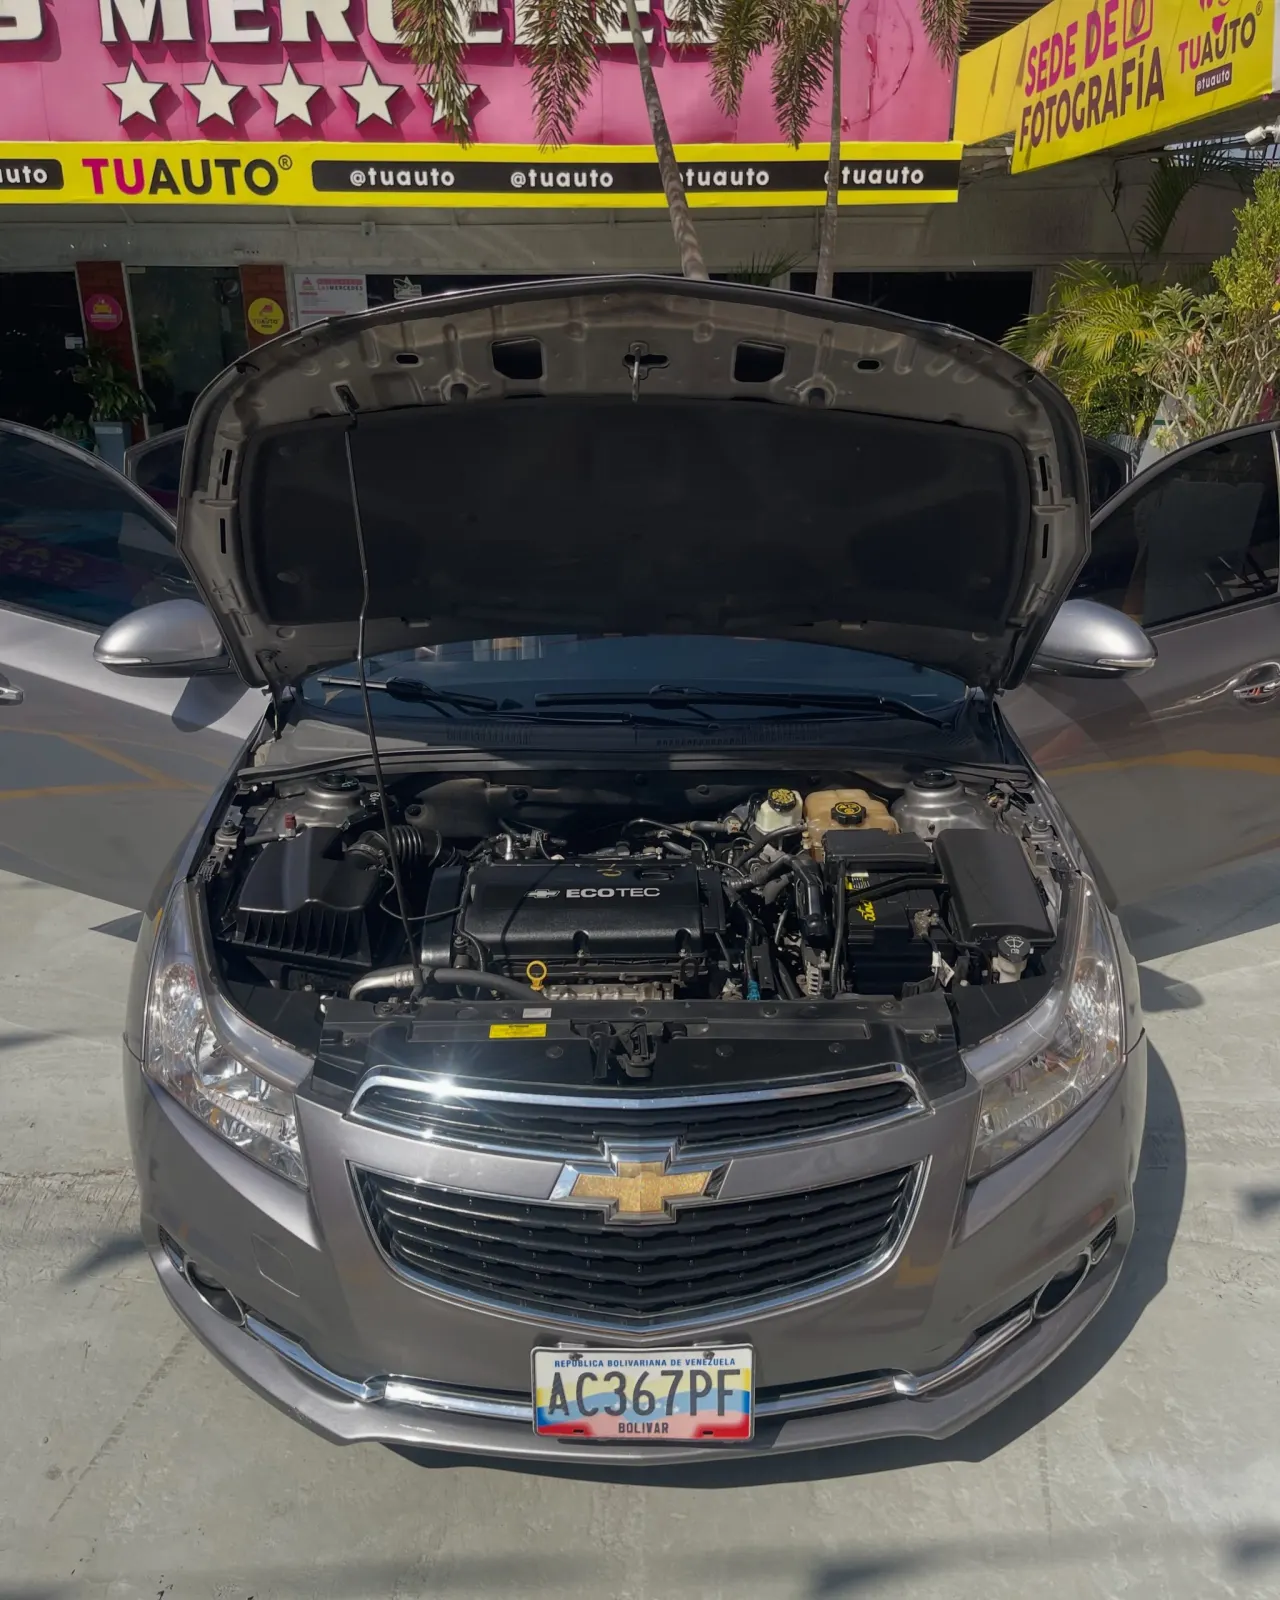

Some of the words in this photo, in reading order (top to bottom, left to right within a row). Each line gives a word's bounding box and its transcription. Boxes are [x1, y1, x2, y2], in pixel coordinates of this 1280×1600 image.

[1025, 21, 1078, 97] SEDE
[1084, 0, 1119, 69] DE
[1196, 69, 1231, 92] @tuauto
[1019, 44, 1165, 152] FOTOGRAFÍA
[350, 167, 455, 187] @tuauto
[510, 168, 614, 188] @tuauto
[679, 168, 770, 187] tuauto
[565, 887, 661, 899] ECOTEC
[607, 1359, 667, 1368] BOLIVARIANA
[670, 1359, 682, 1367] DE
[685, 1358, 736, 1367] VENEZUELA
[547, 1369, 741, 1417] AC367PF
[618, 1422, 669, 1434] BOLIVAR
